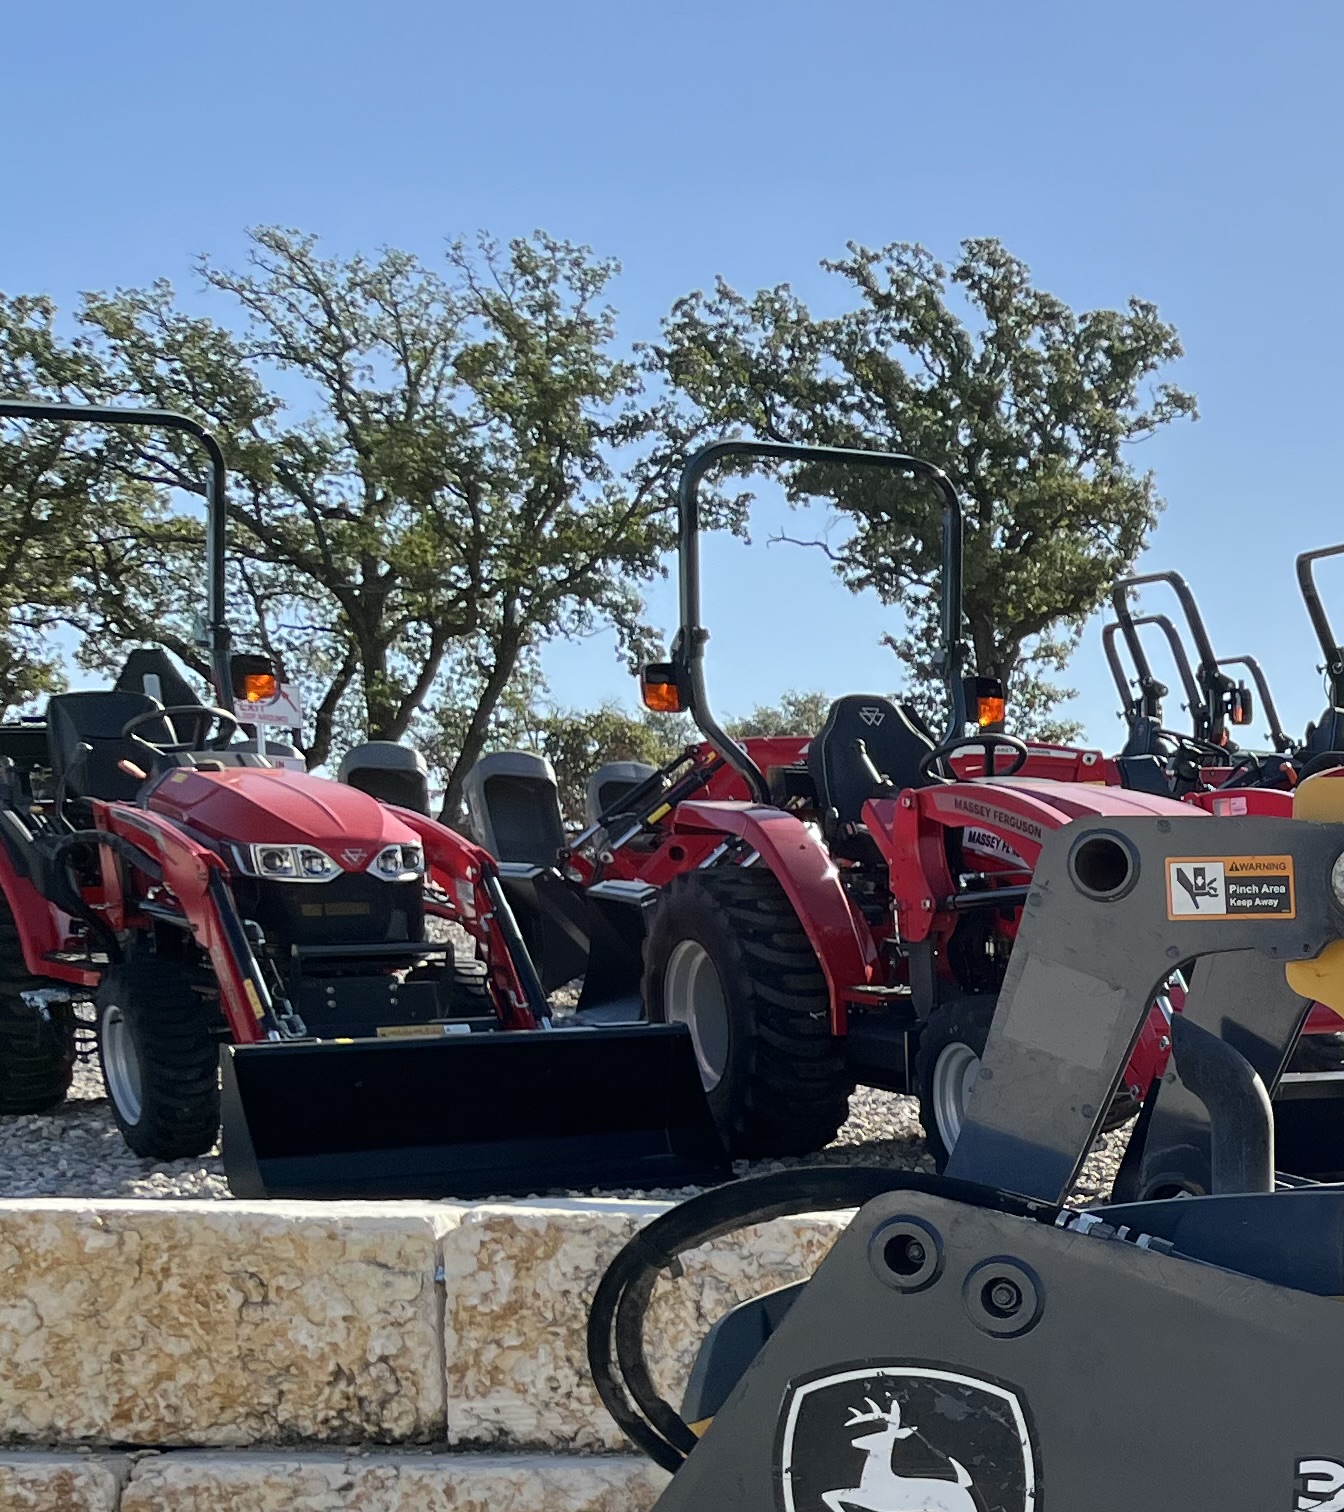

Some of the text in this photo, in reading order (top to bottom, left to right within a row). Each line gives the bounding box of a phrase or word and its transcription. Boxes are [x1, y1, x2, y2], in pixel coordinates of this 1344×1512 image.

[954, 798, 1042, 839] MASSEY FERGUSON
[968, 830, 1001, 850] MASSEY
[1239, 861, 1287, 872] WARNING
[1228, 884, 1287, 895] Pinch Area
[1229, 898, 1280, 908] Keep Away
